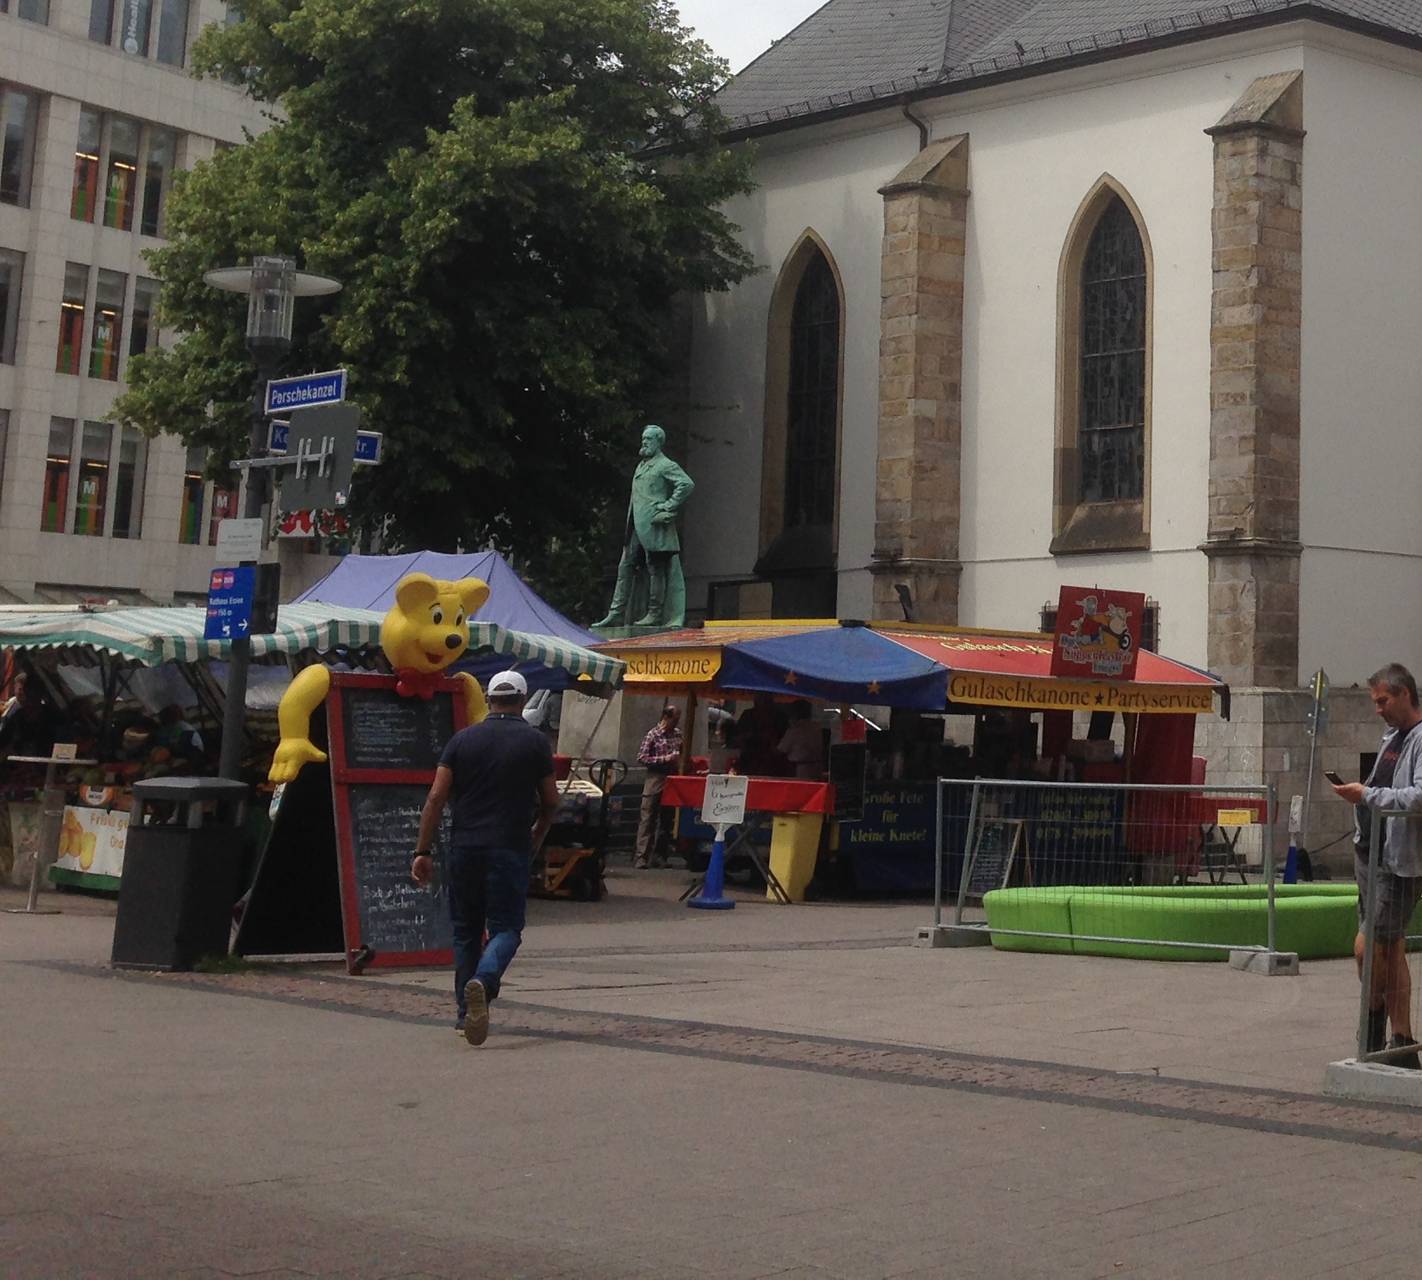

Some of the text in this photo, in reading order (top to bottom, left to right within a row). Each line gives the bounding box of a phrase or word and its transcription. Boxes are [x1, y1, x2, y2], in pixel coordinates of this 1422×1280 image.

[271, 381, 337, 405] Porschekanzel
[951, 676, 1211, 712] Gulaschkanone Partyservice
